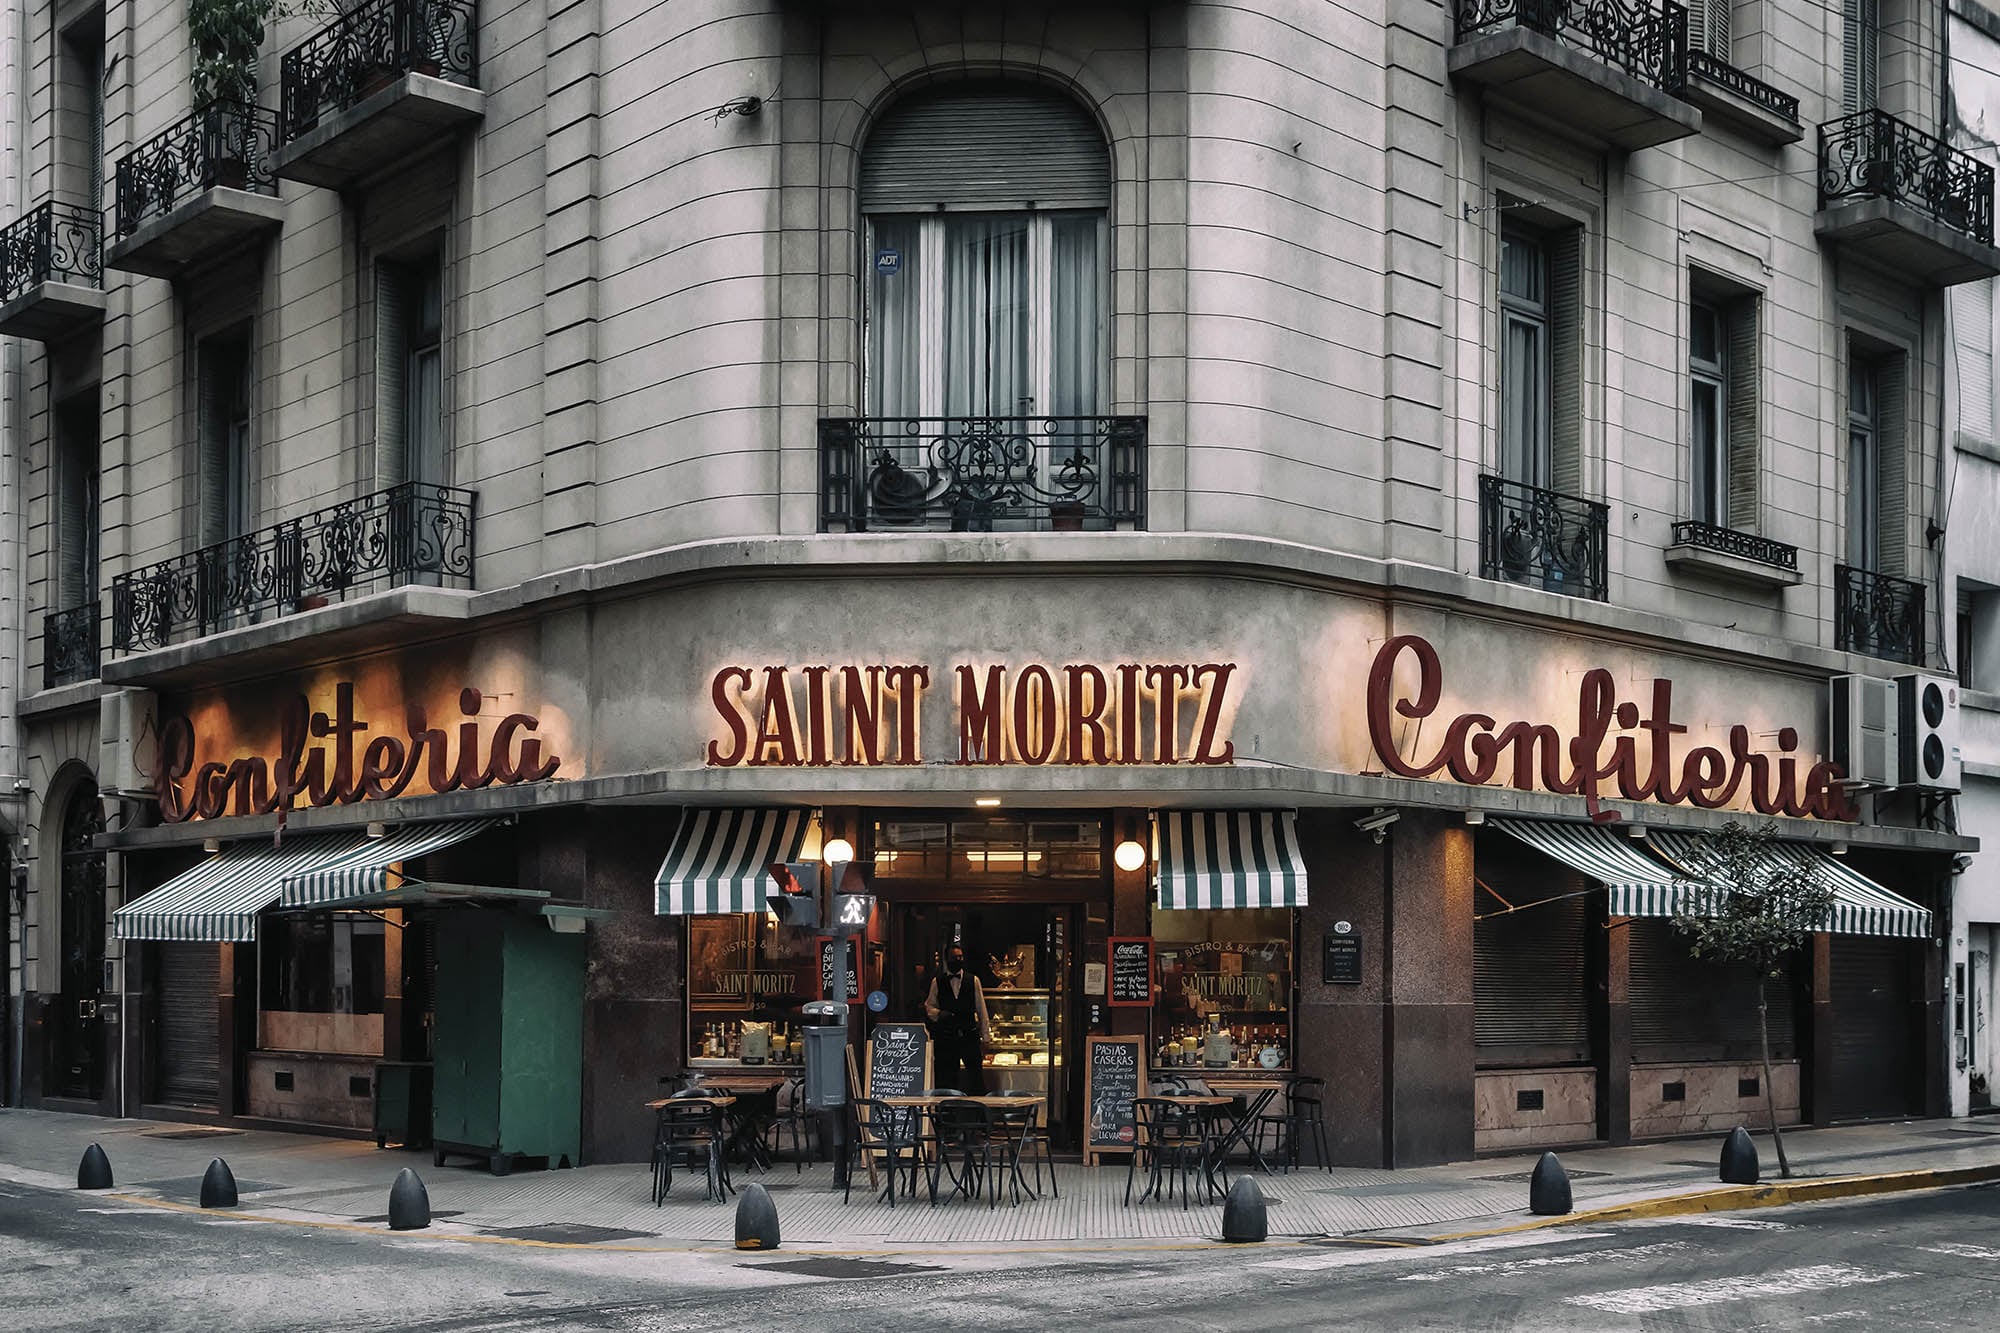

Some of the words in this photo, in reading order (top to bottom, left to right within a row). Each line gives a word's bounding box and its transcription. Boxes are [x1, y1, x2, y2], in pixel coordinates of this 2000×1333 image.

[879, 255, 897, 265] ADT
[706, 665, 930, 767] SAINT
[955, 664, 1237, 765] MORITZ
[1366, 635, 1861, 823] Confiteria
[158, 682, 561, 842] Confiteria
[722, 939, 757, 956] BISTRO
[1184, 941, 1222, 958] BISTRO
[1225, 941, 1233, 950] &
[1237, 944, 1257, 956] BAR
[716, 974, 748, 993] SAINT
[753, 974, 796, 993] MORITZ
[1181, 976, 1215, 995] SAINT
[1218, 976, 1264, 995] MORITZ
[876, 1031, 920, 1051] Saint
[1095, 1045, 1127, 1056] PASTAS
[1094, 1055, 1134, 1065] CASERAS
